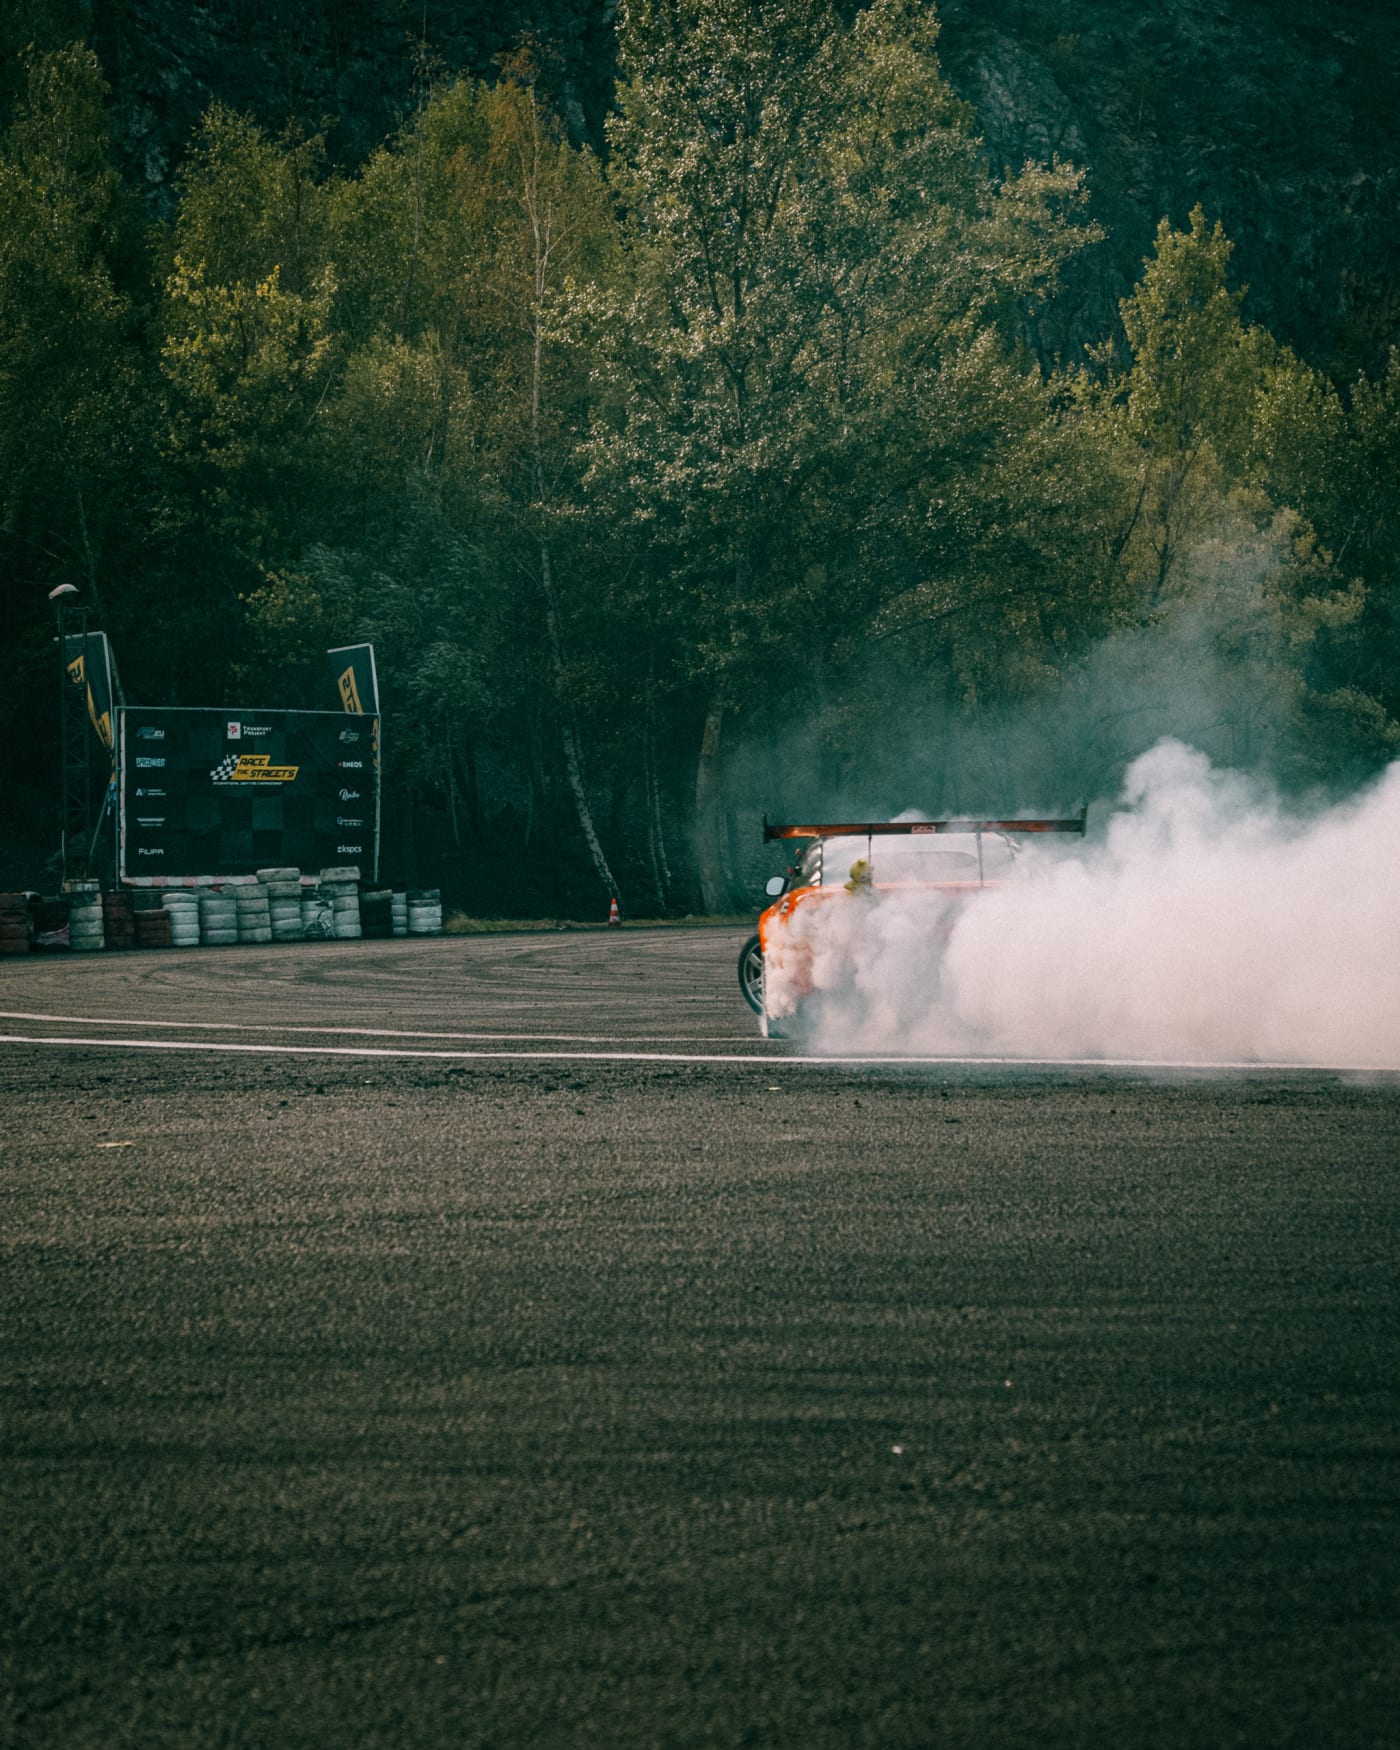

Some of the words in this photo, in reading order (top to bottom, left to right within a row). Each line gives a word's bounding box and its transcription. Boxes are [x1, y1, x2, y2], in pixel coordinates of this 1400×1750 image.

[240, 758, 266, 766] RACE
[342, 760, 363, 768] ENEOS
[250, 769, 295, 778] STREETS
